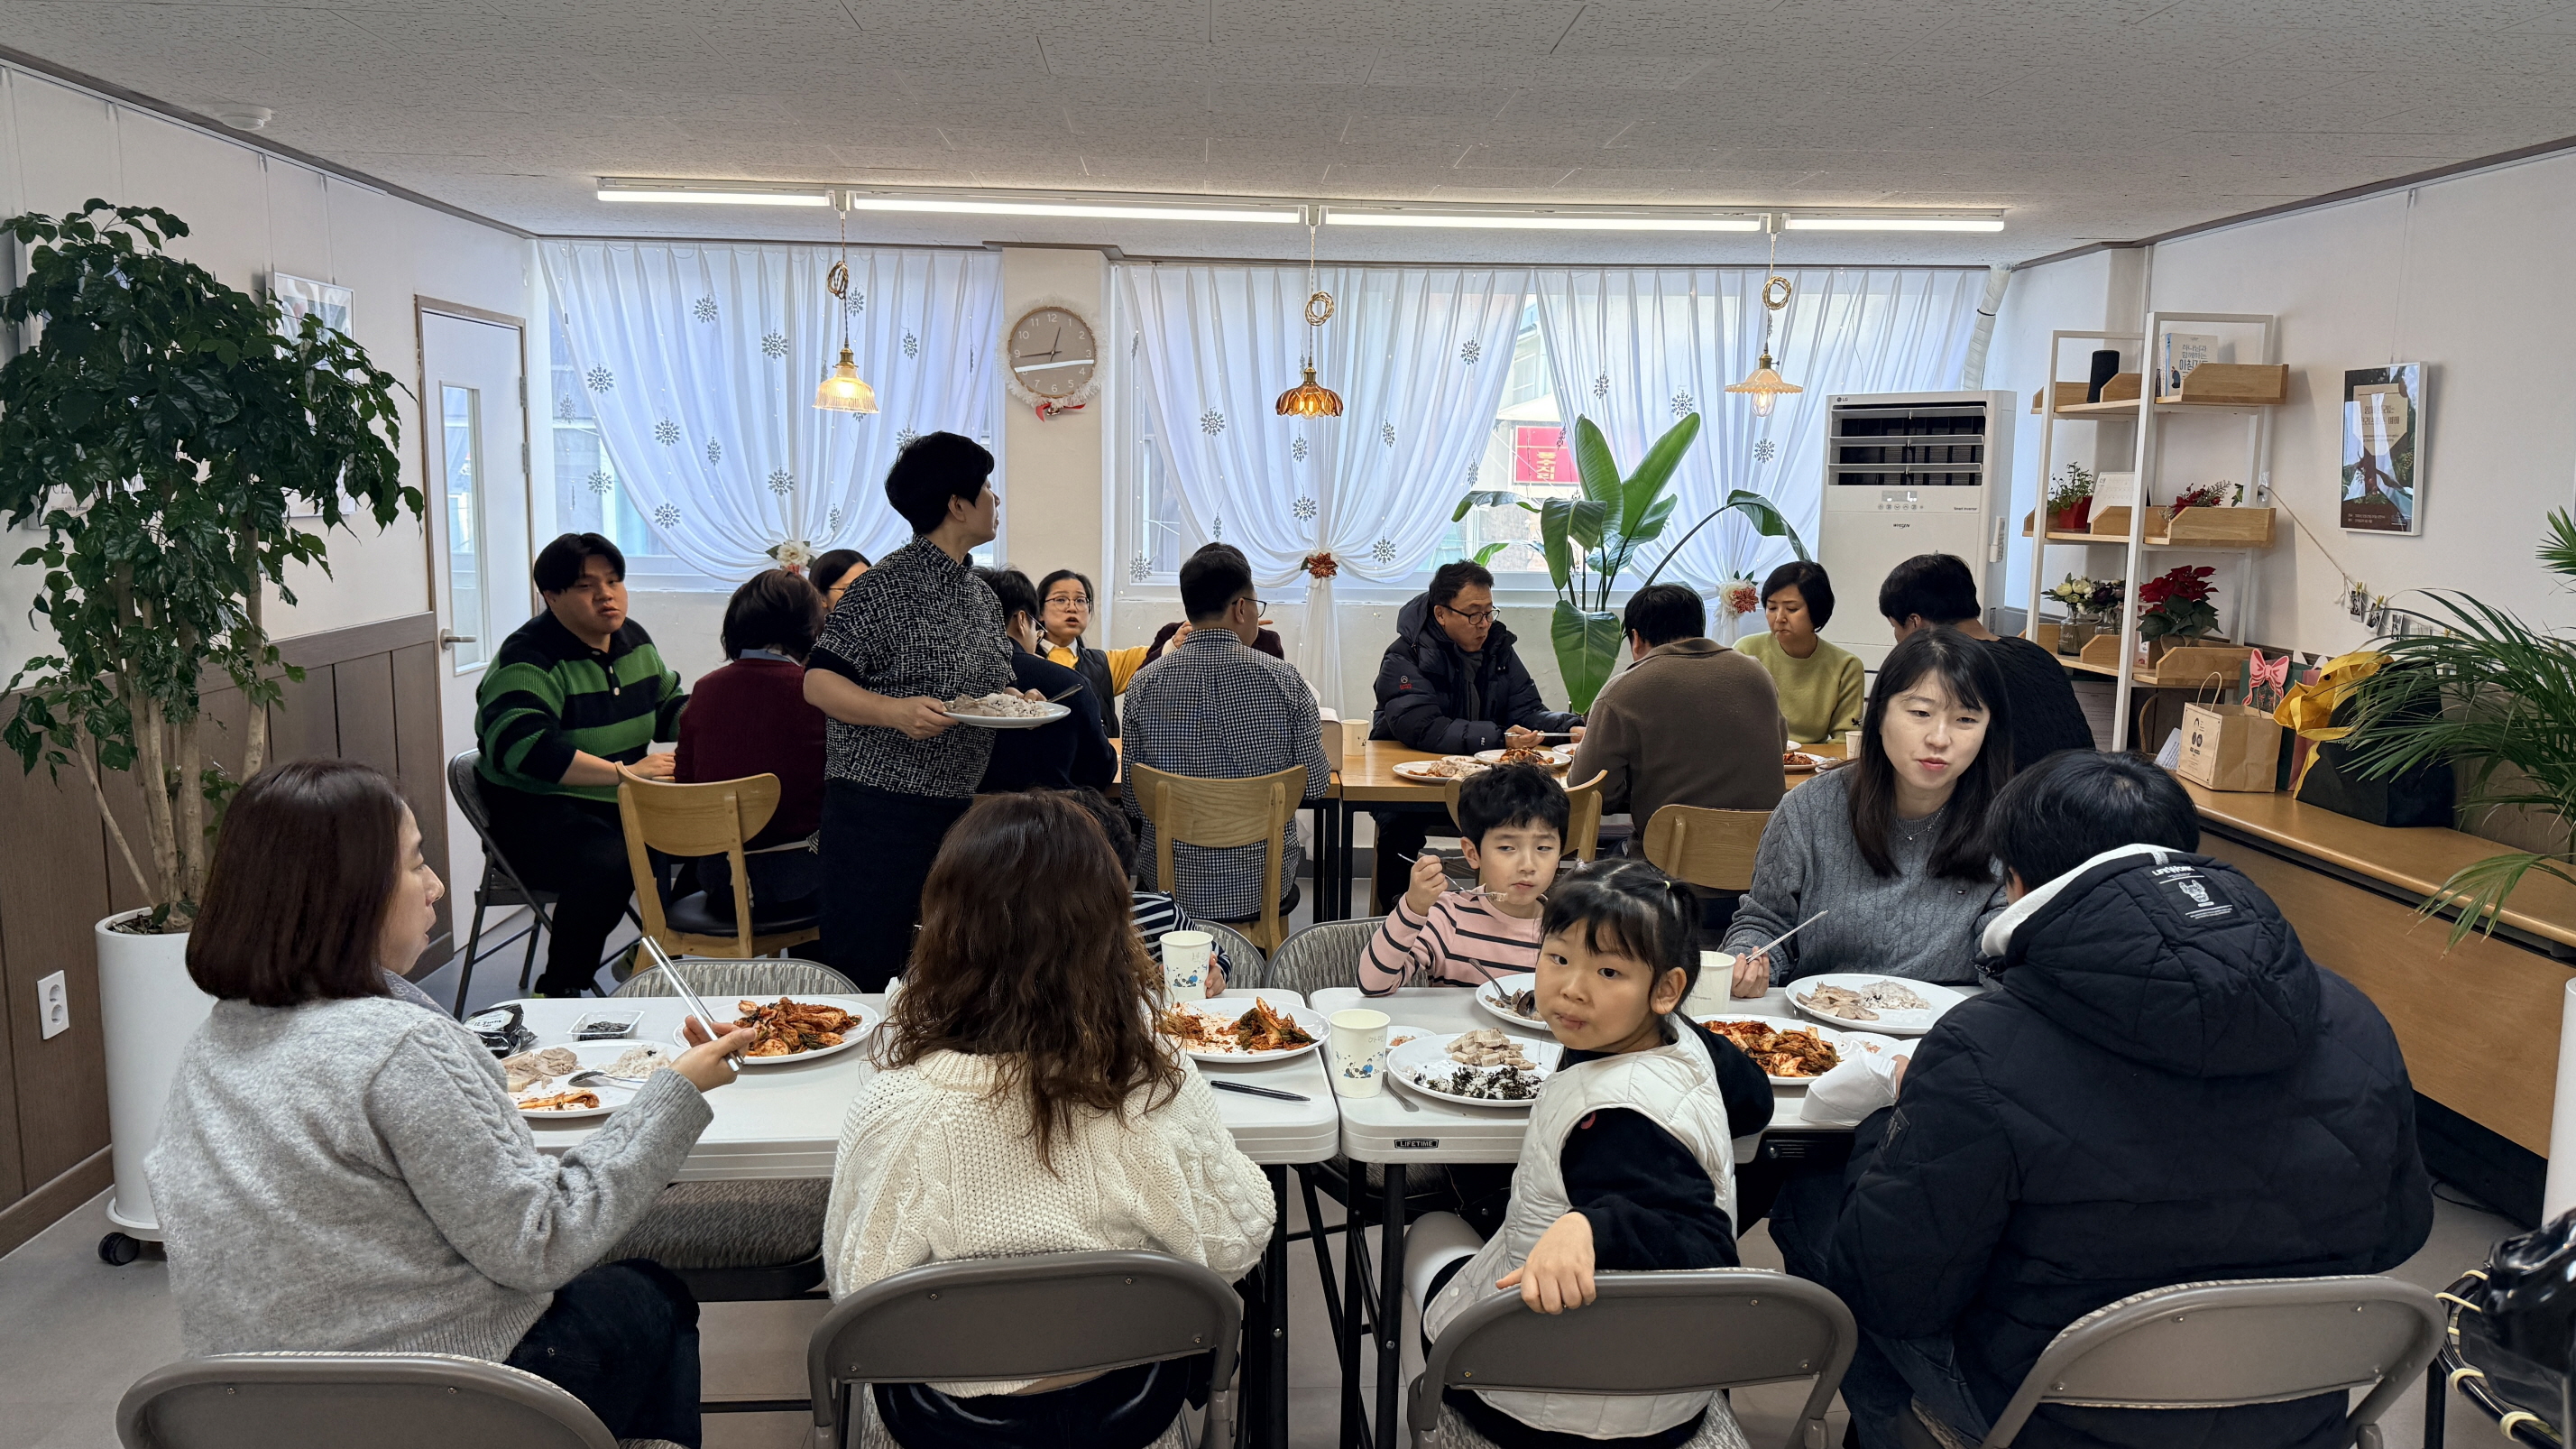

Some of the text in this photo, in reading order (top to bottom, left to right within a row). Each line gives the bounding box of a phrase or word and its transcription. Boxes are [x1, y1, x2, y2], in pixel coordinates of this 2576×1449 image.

[1047, 313, 1057, 323] 12
[1030, 318, 1039, 327] 11
[1068, 318, 1072, 327] 1
[1018, 331, 1029, 339] 10
[1079, 331, 1085, 340] 2
[2183, 344, 2207, 353] 하나님과
[1014, 350, 1020, 358] 9
[1086, 350, 1091, 358] 3
[2179, 359, 2208, 371] 아침기
[1079, 367, 1086, 375] 4
[1035, 380, 1040, 388] 7
[1051, 384, 1058, 392] 6
[1068, 380, 1074, 388] 5
